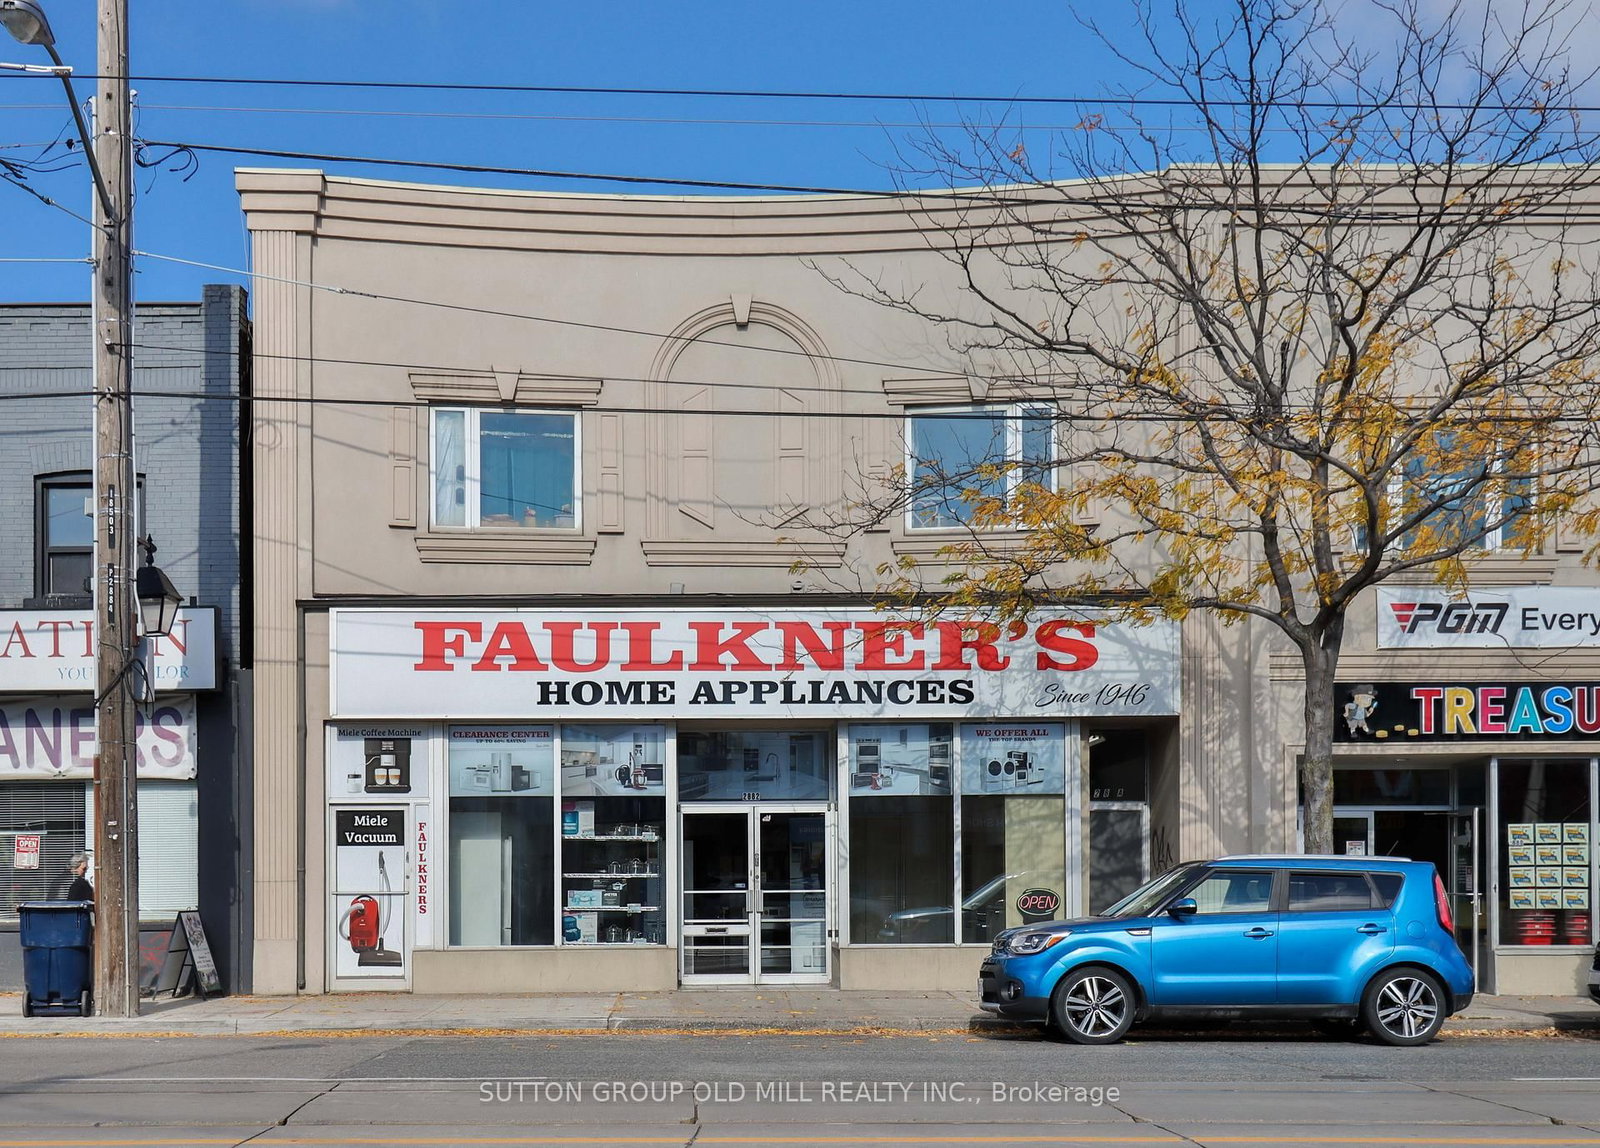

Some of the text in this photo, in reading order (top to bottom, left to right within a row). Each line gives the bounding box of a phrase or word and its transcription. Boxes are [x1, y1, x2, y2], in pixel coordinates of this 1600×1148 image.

[0, 620, 192, 658] ATIN
[414, 620, 1099, 672] FAULKNER'S
[57, 666, 94, 680] YOU
[536, 680, 1151, 707] HOME APPLIANCES Since 1946
[1412, 687, 1600, 734] TREASU
[338, 729, 422, 737] Miele Coffee Machine
[453, 731, 509, 739] CLEARANCE
[354, 815, 388, 826] Miele
[345, 832, 397, 843] Vacuum
[418, 822, 427, 914] FAULKNERS
[1020, 895, 1055, 909] OPEN
